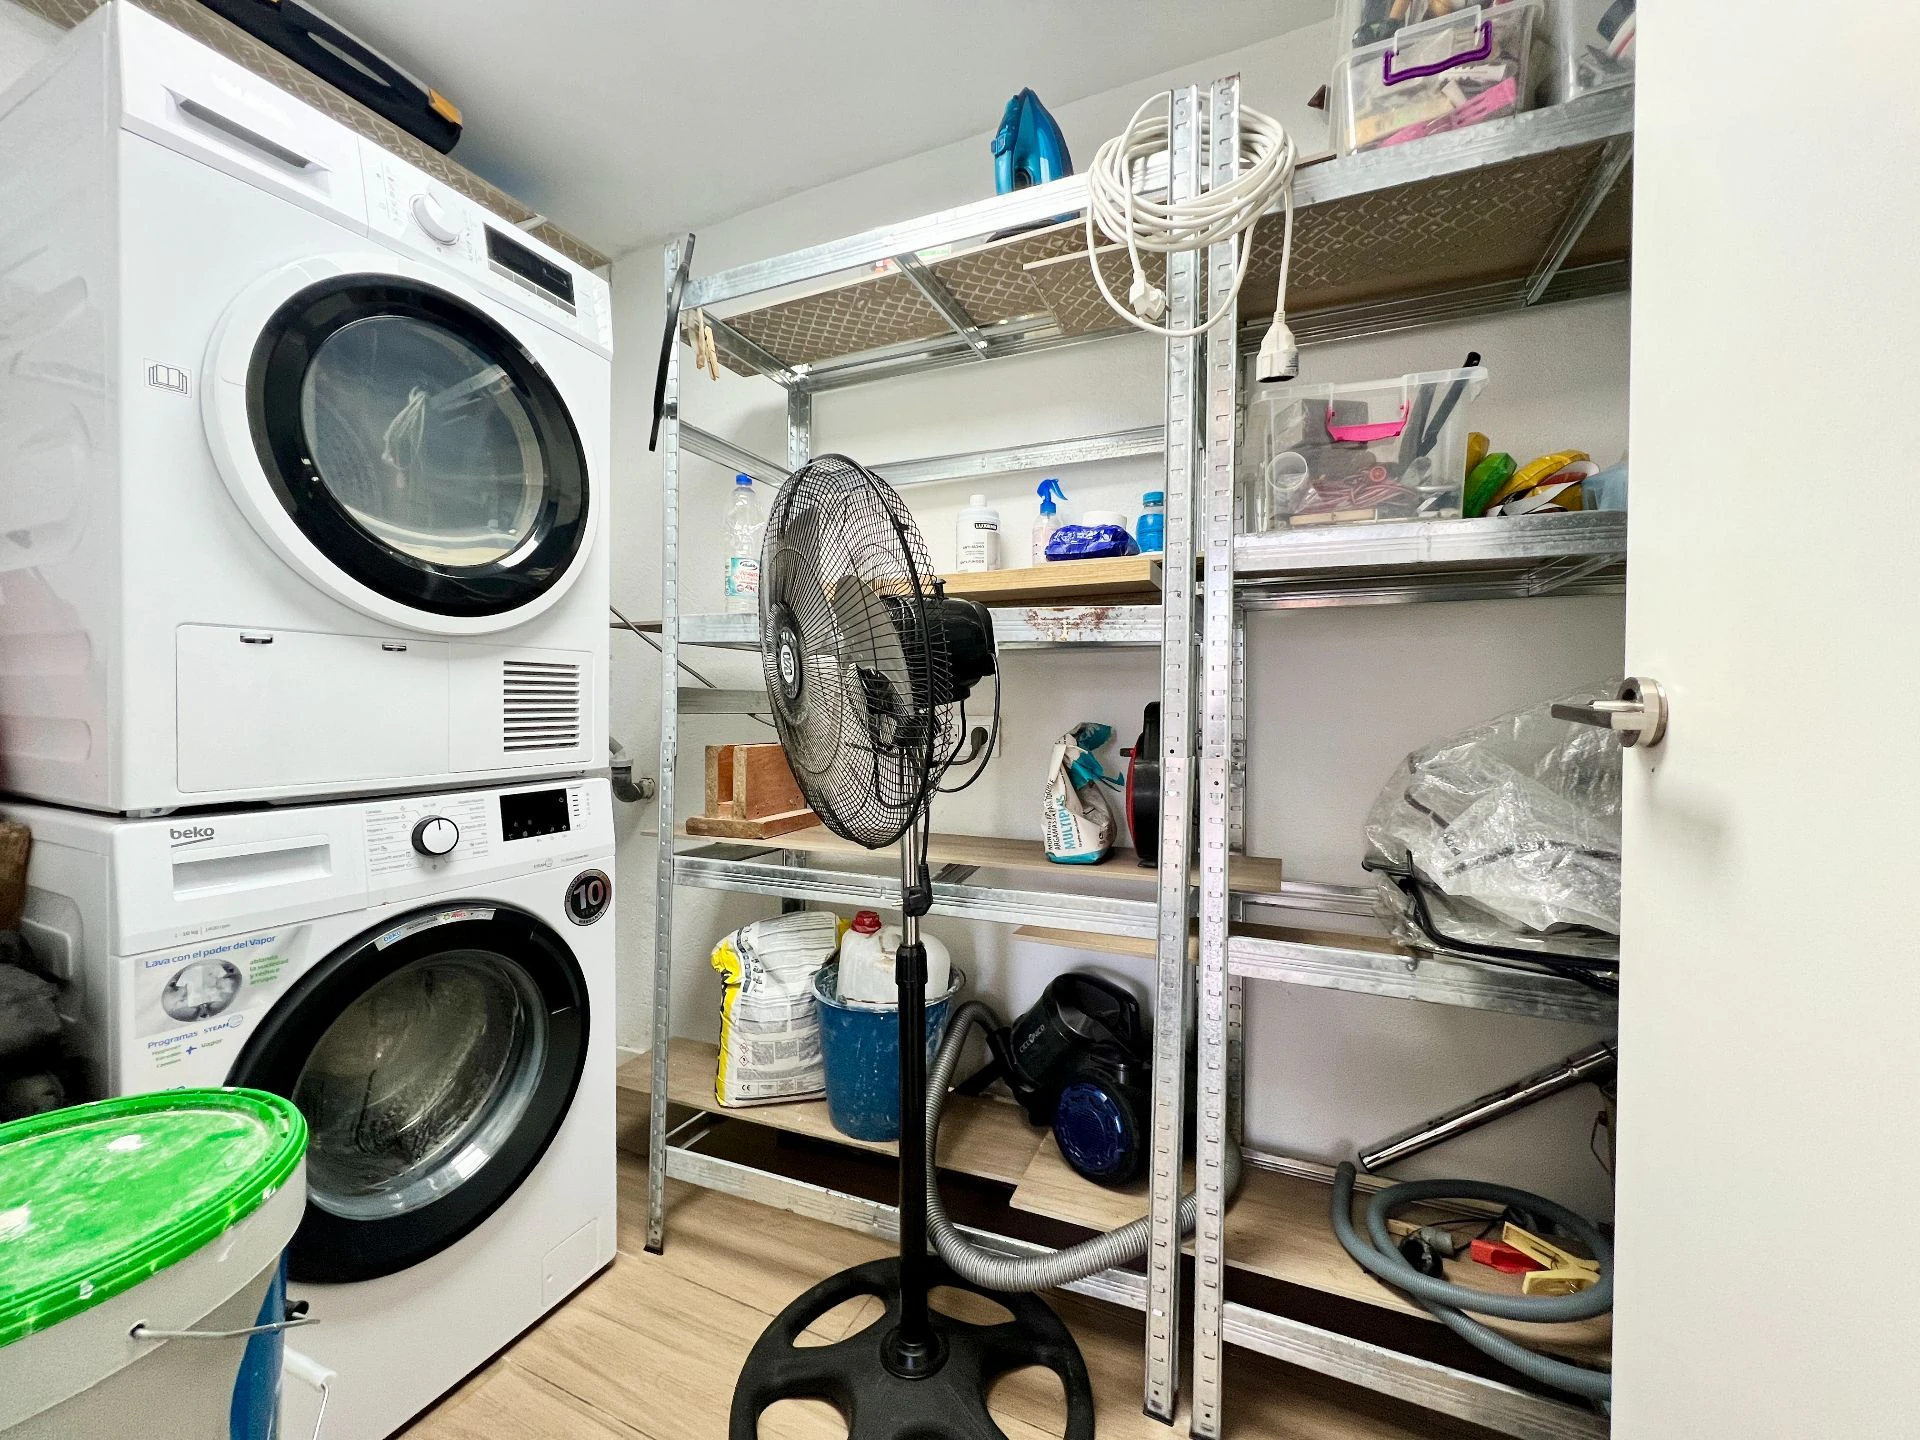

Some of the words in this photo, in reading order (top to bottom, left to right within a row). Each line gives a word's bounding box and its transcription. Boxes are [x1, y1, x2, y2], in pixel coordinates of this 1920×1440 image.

[169, 826, 215, 840] beko
[574, 880, 604, 910] 10
[145, 957, 171, 969] Lava
[172, 953, 191, 963] con
[192, 949, 202, 959] el
[203, 944, 232, 959] poder
[233, 940, 248, 950] del
[249, 935, 276, 948] Vapor
[147, 1031, 199, 1049] Programas
